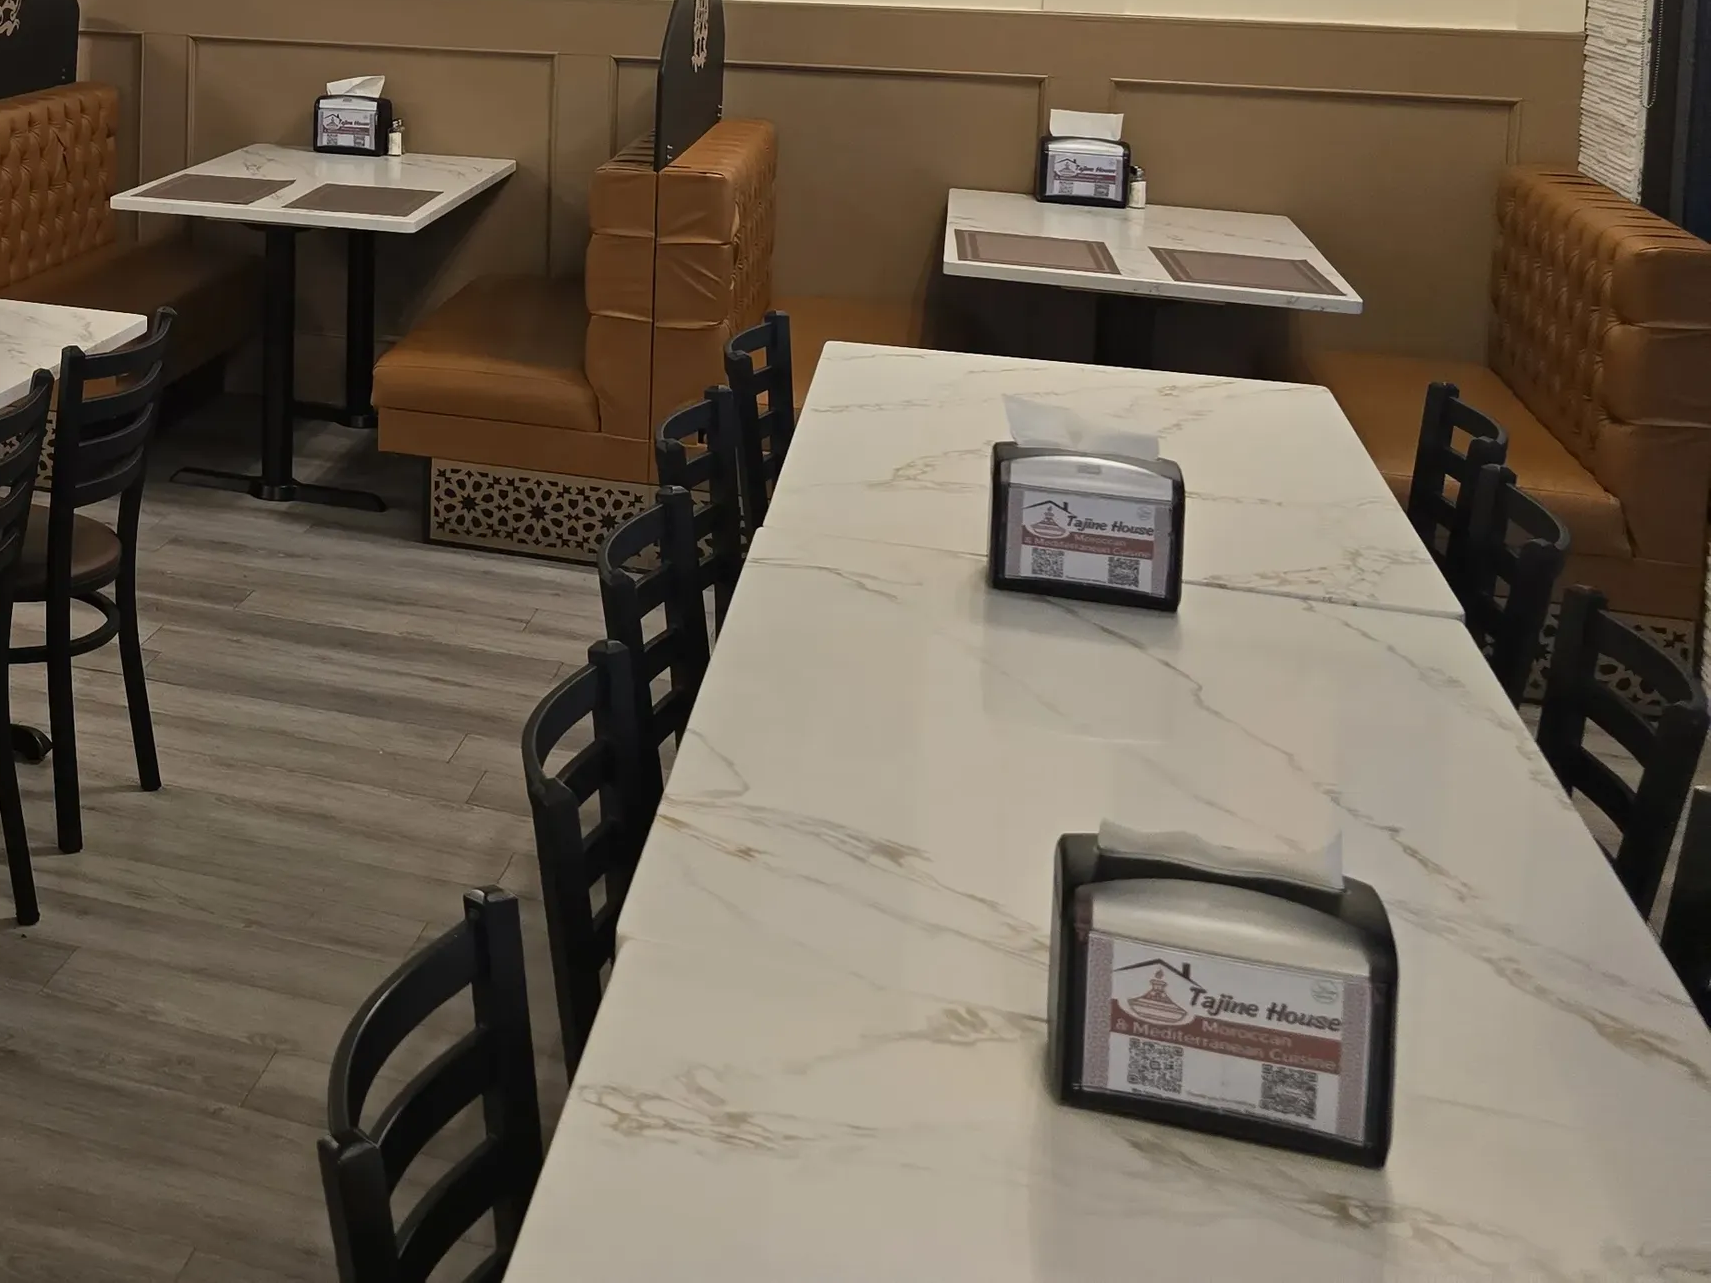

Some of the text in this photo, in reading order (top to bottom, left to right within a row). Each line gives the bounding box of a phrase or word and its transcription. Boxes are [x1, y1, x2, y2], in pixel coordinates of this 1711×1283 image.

[1067, 515, 1155, 536] Tajine House
[1074, 533, 1127, 547] Moroccan
[1189, 986, 1342, 1032] Tajine House
[1115, 1016, 1338, 1071] & Mediterranean Cuisine
[1200, 1019, 1293, 1048] Moroccan
